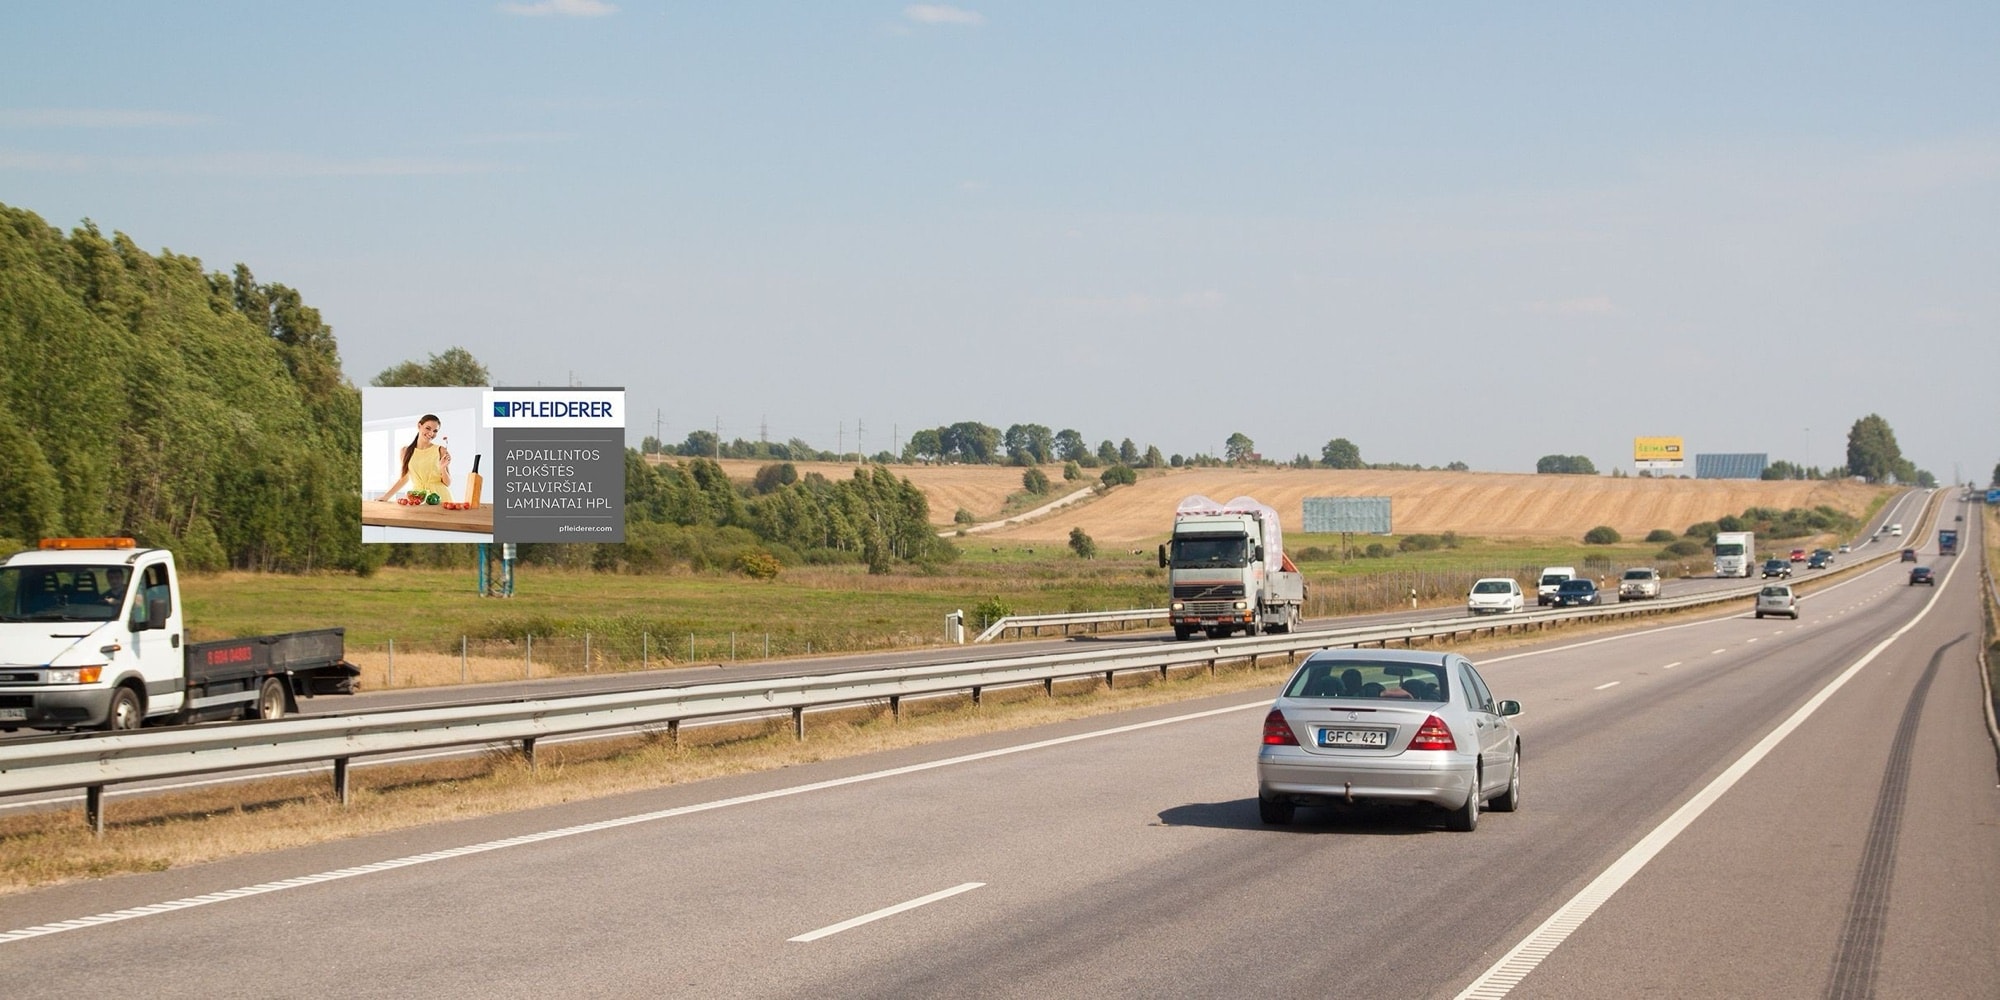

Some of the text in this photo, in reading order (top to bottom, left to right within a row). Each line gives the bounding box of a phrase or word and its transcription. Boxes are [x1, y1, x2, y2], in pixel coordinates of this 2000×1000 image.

[511, 401, 613, 418] PFLEIDERER
[506, 449, 600, 461] APDAILINTOS
[506, 464, 575, 477] PLOKŠTĖS
[506, 480, 593, 493] STALVIRŠIAI
[506, 498, 613, 509] LAMINATAI HPL
[559, 525, 613, 533] pfleiderer.com
[1327, 731, 1384, 744] GFC 421
